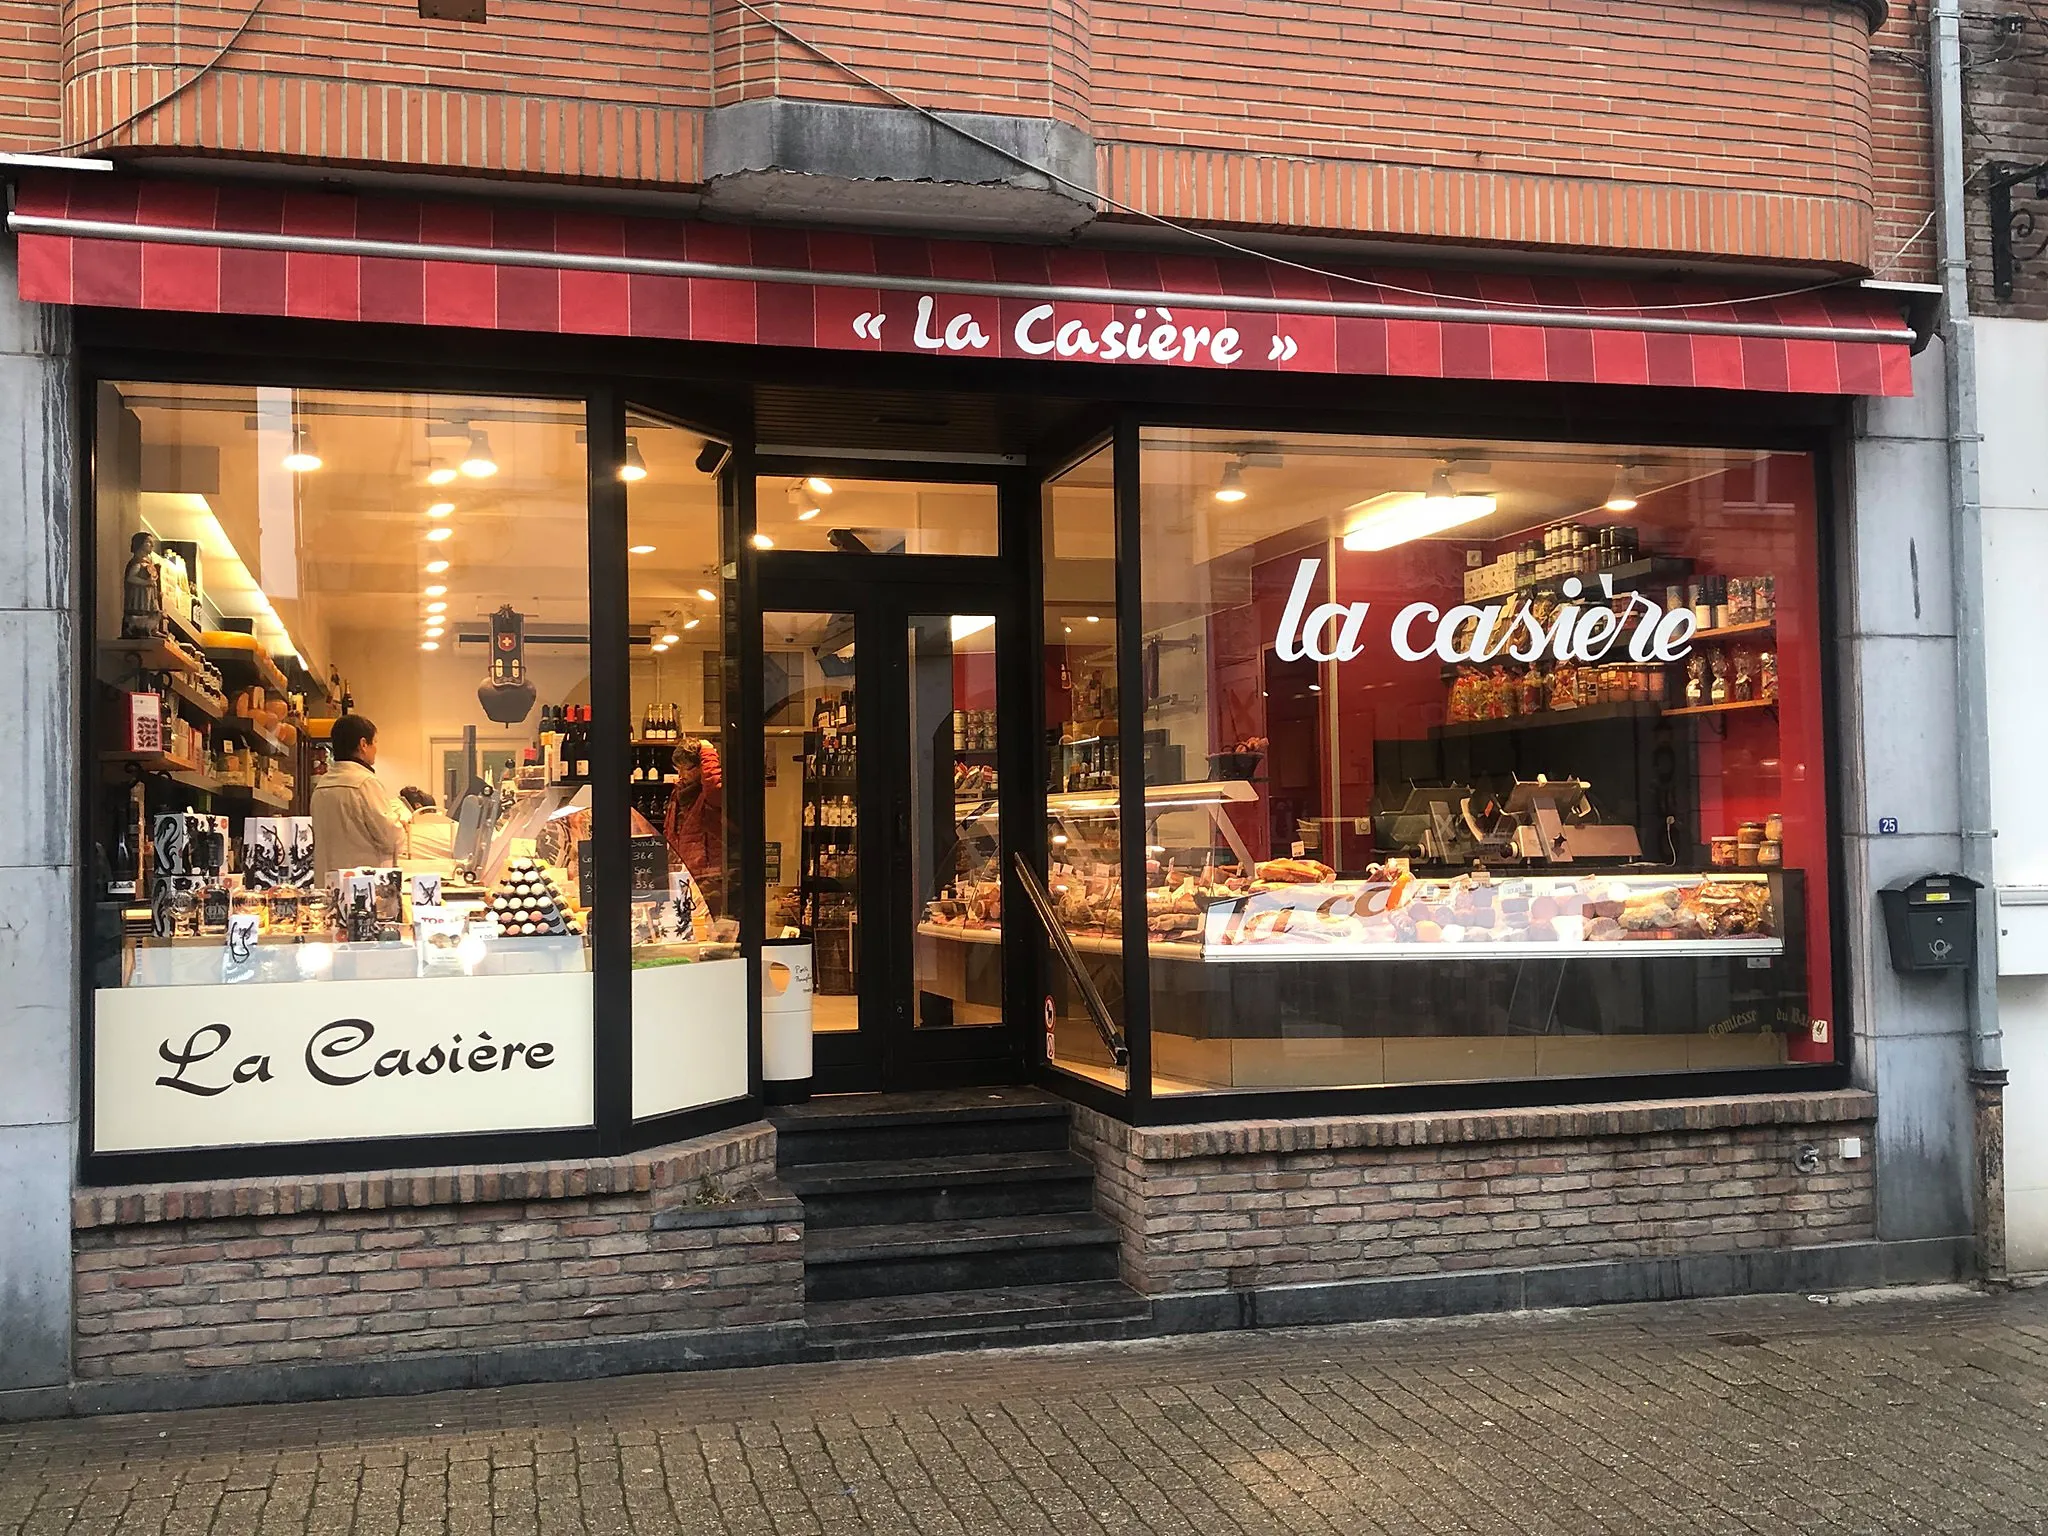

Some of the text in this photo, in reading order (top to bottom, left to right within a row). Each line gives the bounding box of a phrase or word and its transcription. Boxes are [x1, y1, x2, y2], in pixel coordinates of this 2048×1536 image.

[913, 295, 990, 351] La
[1014, 304, 1244, 369] Casière
[1275, 558, 1698, 664] la casière
[1882, 819, 1896, 833] 25
[155, 1018, 556, 1097] La Casière
